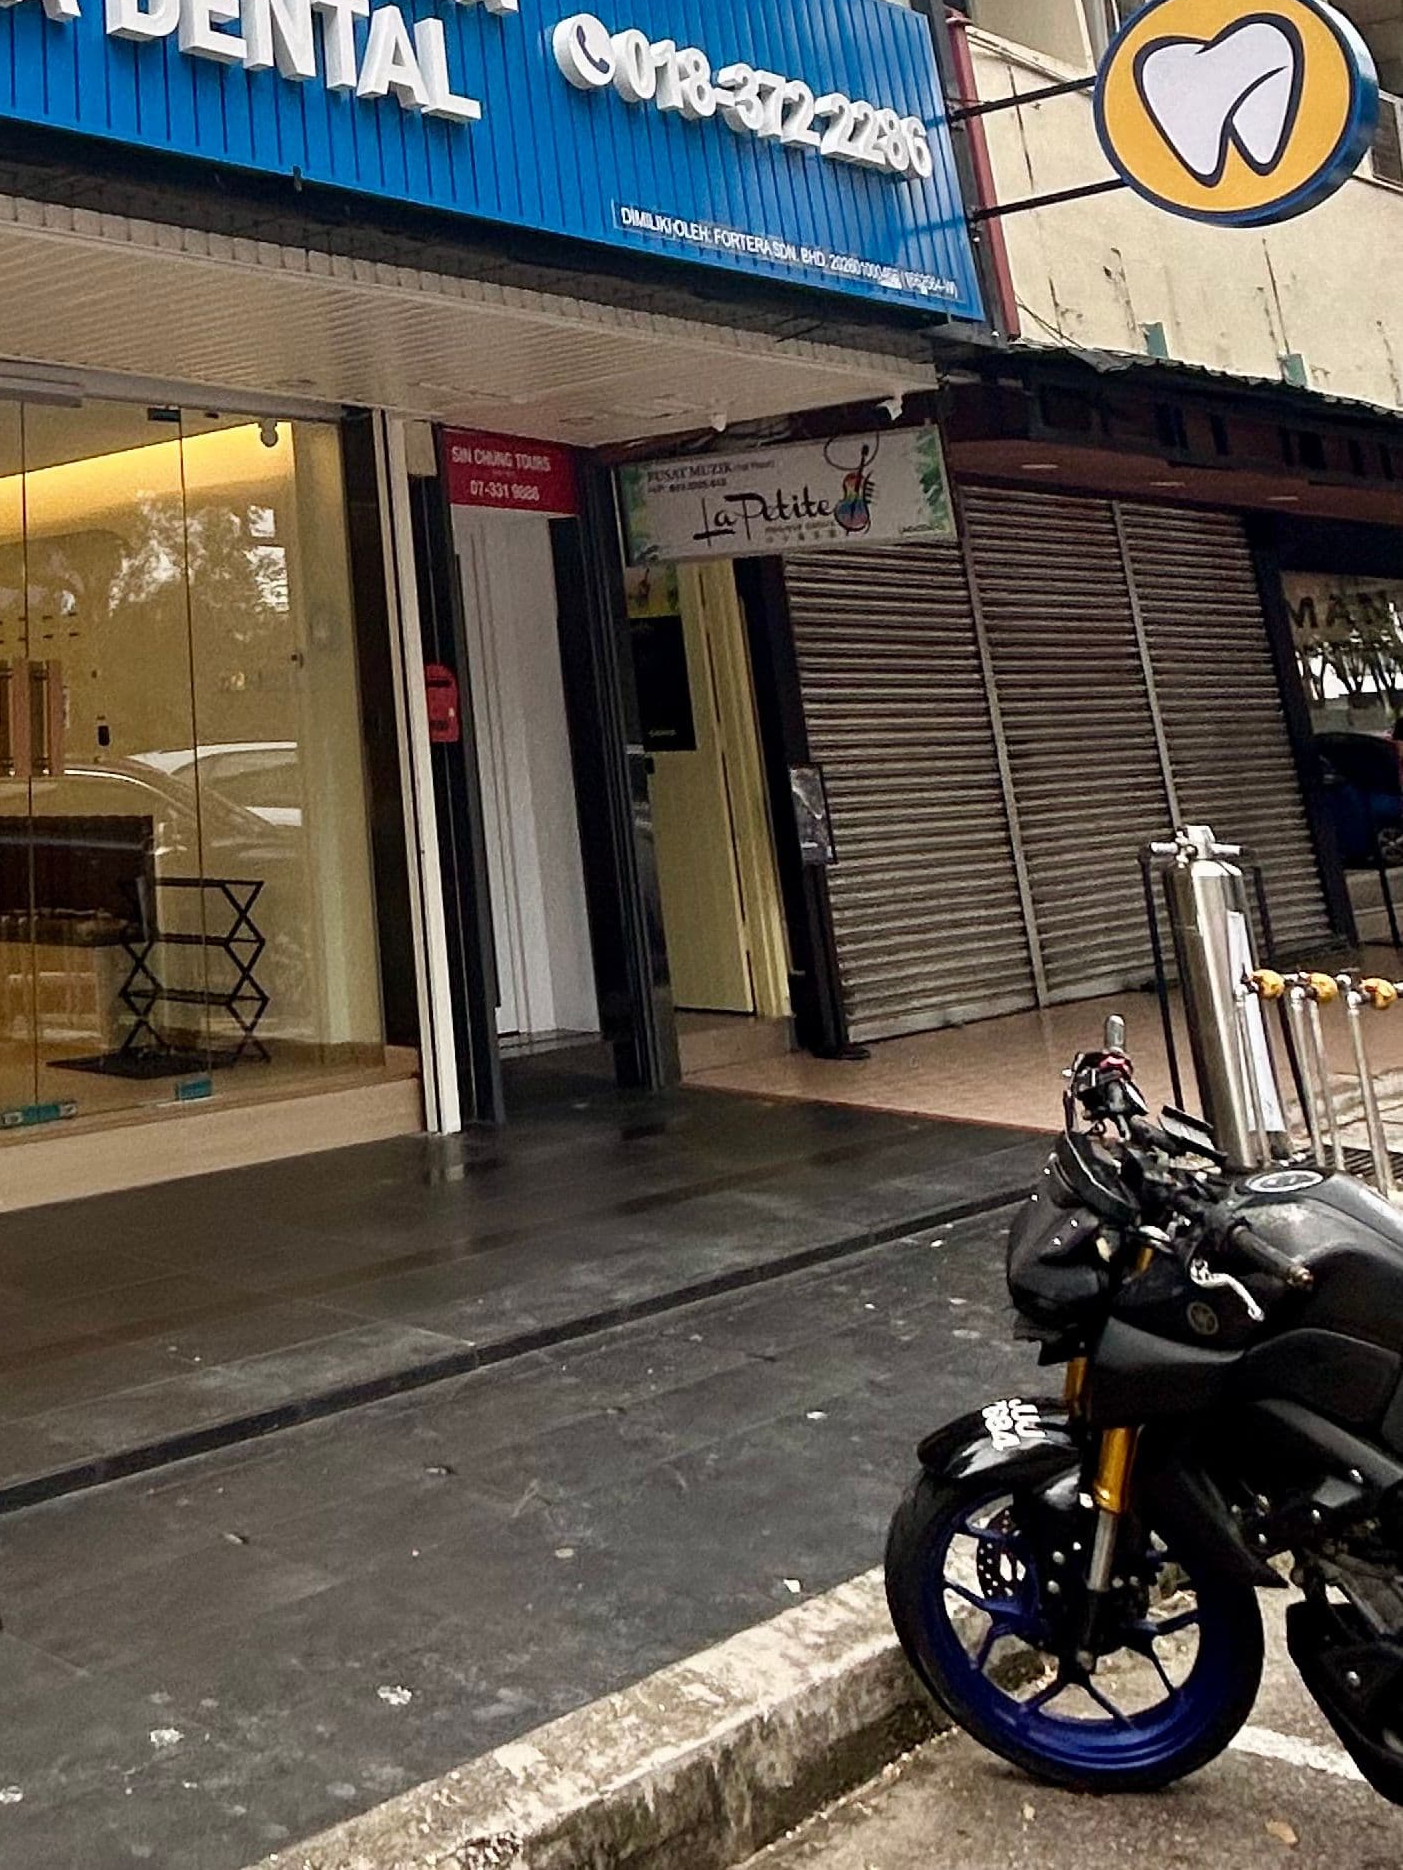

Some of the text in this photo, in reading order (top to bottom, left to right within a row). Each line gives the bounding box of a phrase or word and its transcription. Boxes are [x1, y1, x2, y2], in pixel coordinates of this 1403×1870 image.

[621, 206, 672, 234] DIMILIKI
[714, 228, 772, 256] FORTERA
[452, 446, 552, 472] SIN CHUNG TOURS
[693, 485, 835, 546] La Petite
